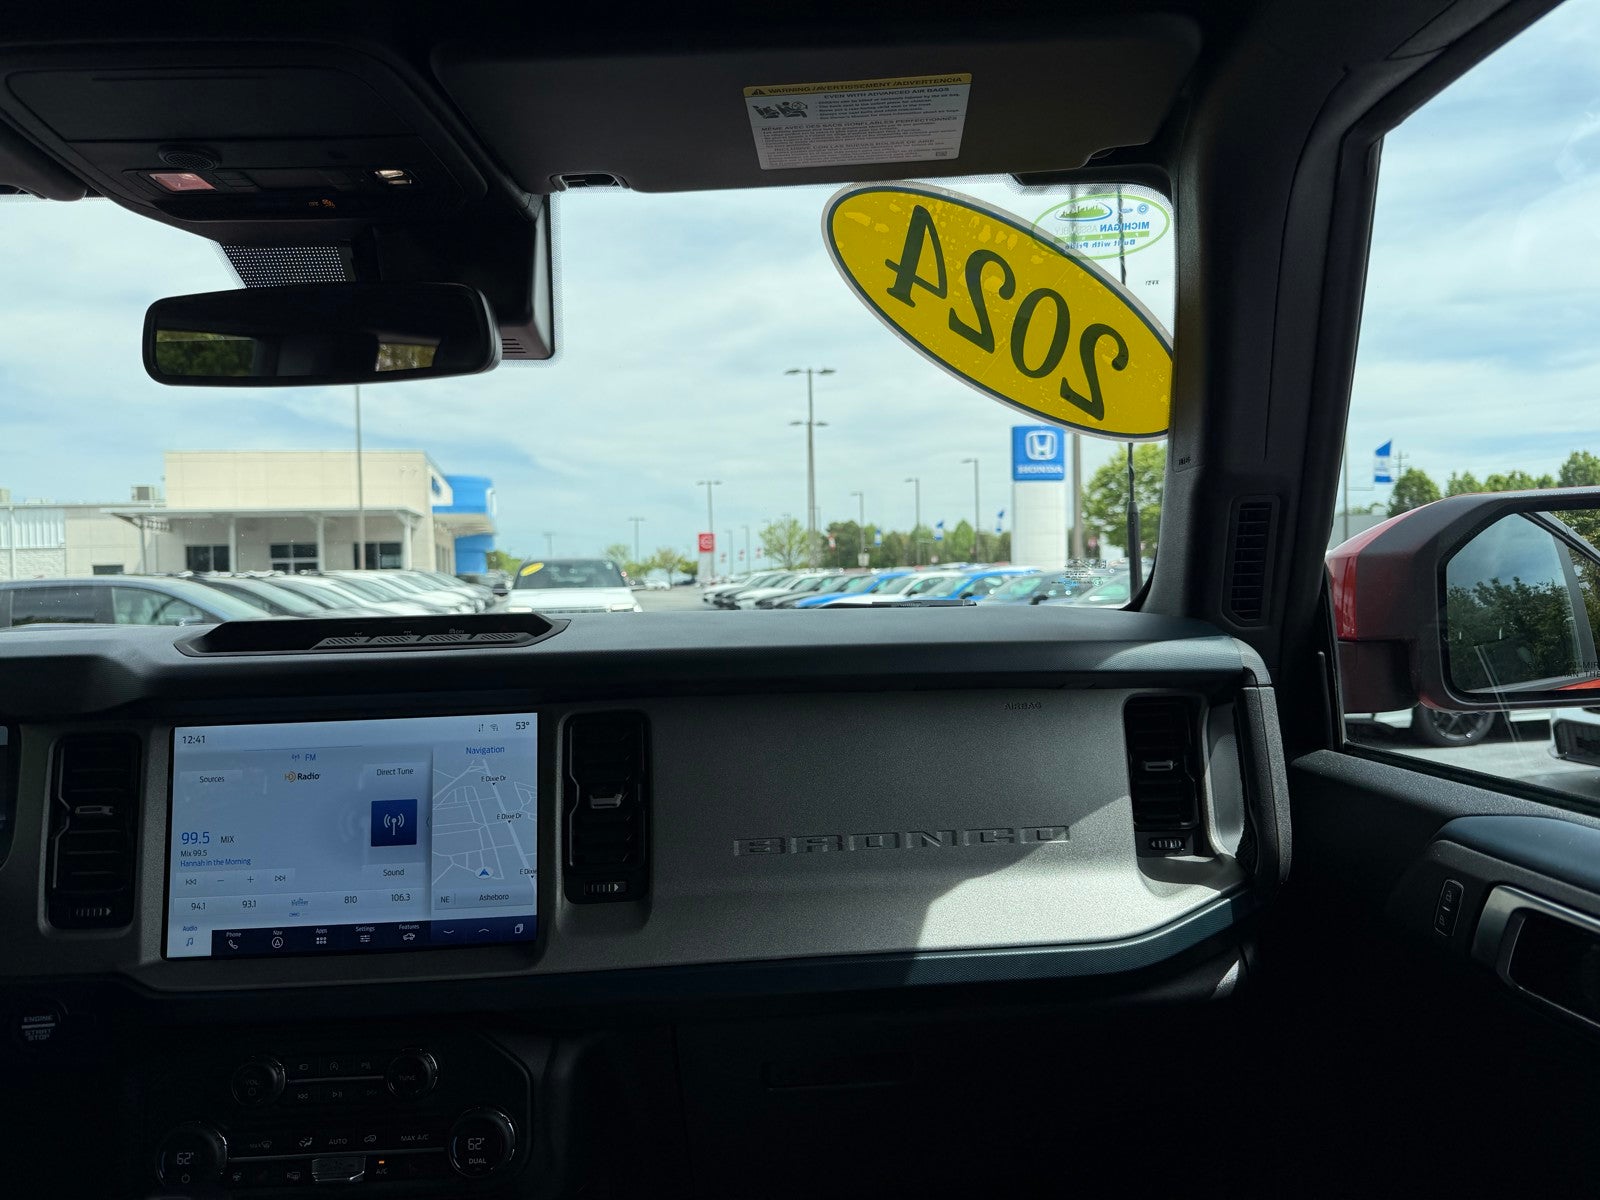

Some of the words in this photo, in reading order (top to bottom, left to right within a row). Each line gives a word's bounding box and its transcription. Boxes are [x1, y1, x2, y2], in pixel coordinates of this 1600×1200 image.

[768, 86, 811, 95] WARNING
[182, 735, 206, 744] 12:41
[466, 745, 505, 756] Navigation
[305, 753, 316, 761] FM
[297, 769, 320, 781] Radio
[376, 767, 395, 777] Direct
[397, 767, 414, 776] Tune
[199, 775, 224, 784] Sources
[181, 831, 210, 845] 99.5
[221, 835, 235, 844] MIX
[734, 825, 1070, 857] BRONCO
[180, 850, 192, 858] Mix
[193, 849, 208, 857] 99.5
[180, 859, 206, 868] Hannah
[213, 858, 224, 866] the
[225, 857, 251, 867] Morning
[383, 868, 405, 877] Sound
[344, 895, 358, 904] 810
[391, 893, 411, 902] 106.3
[479, 892, 510, 902] Asheboro
[191, 902, 206, 912] 94.1
[242, 900, 257, 909] 93.1
[183, 925, 198, 934] Audio
[355, 925, 376, 934] Settings
[398, 922, 421, 931] Features
[226, 931, 242, 939] Phone
[315, 928, 328, 936] Apps
[328, 1136, 348, 1144] AUTO
